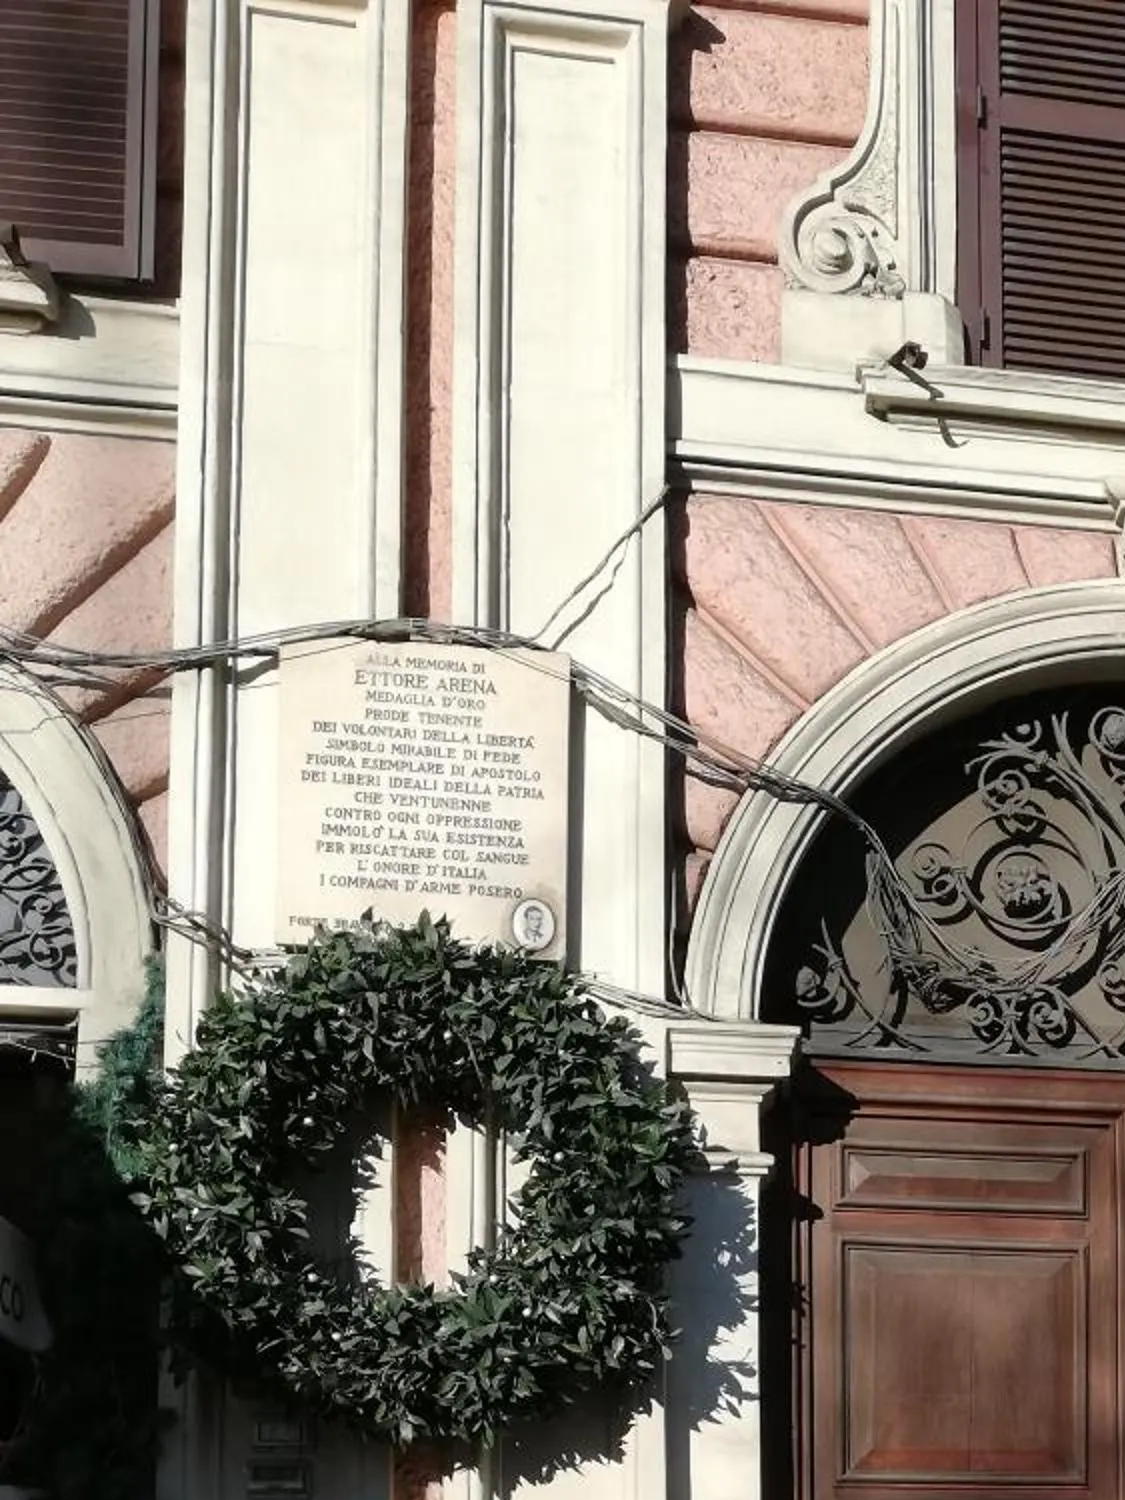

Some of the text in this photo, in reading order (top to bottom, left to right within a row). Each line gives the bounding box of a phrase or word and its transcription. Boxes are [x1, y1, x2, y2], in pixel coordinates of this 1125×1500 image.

[366, 654, 486, 675] ALLA MEMORIA DI
[354, 669, 498, 695] ETTORE ARENA
[365, 690, 486, 711] MEDAGLIA D'ORO
[365, 708, 483, 729] PRODE TENENTE
[312, 721, 337, 733] DEI
[342, 723, 417, 739] VOLONTARI
[423, 729, 471, 745] DELLA
[325, 738, 521, 765] SIMBOLO MIRABILE DI FEDE
[306, 753, 542, 783] FIGURA ESEMPLARE DI APOSTOLO
[301, 769, 545, 800] DEI LIBERI IDEALI DELLA PATRIA
[354, 791, 385, 805] CHE
[325, 807, 523, 832] CONTRO OGNI OPPRESSIONE
[389, 828, 408, 841] LA
[414, 829, 440, 842] SUA
[446, 832, 525, 849] ESISTENZA
[316, 840, 530, 865] PER RISCATTARE COL SANGUE
[330, 875, 399, 891] COMPAGNI
[469, 884, 524, 899] POSERO
